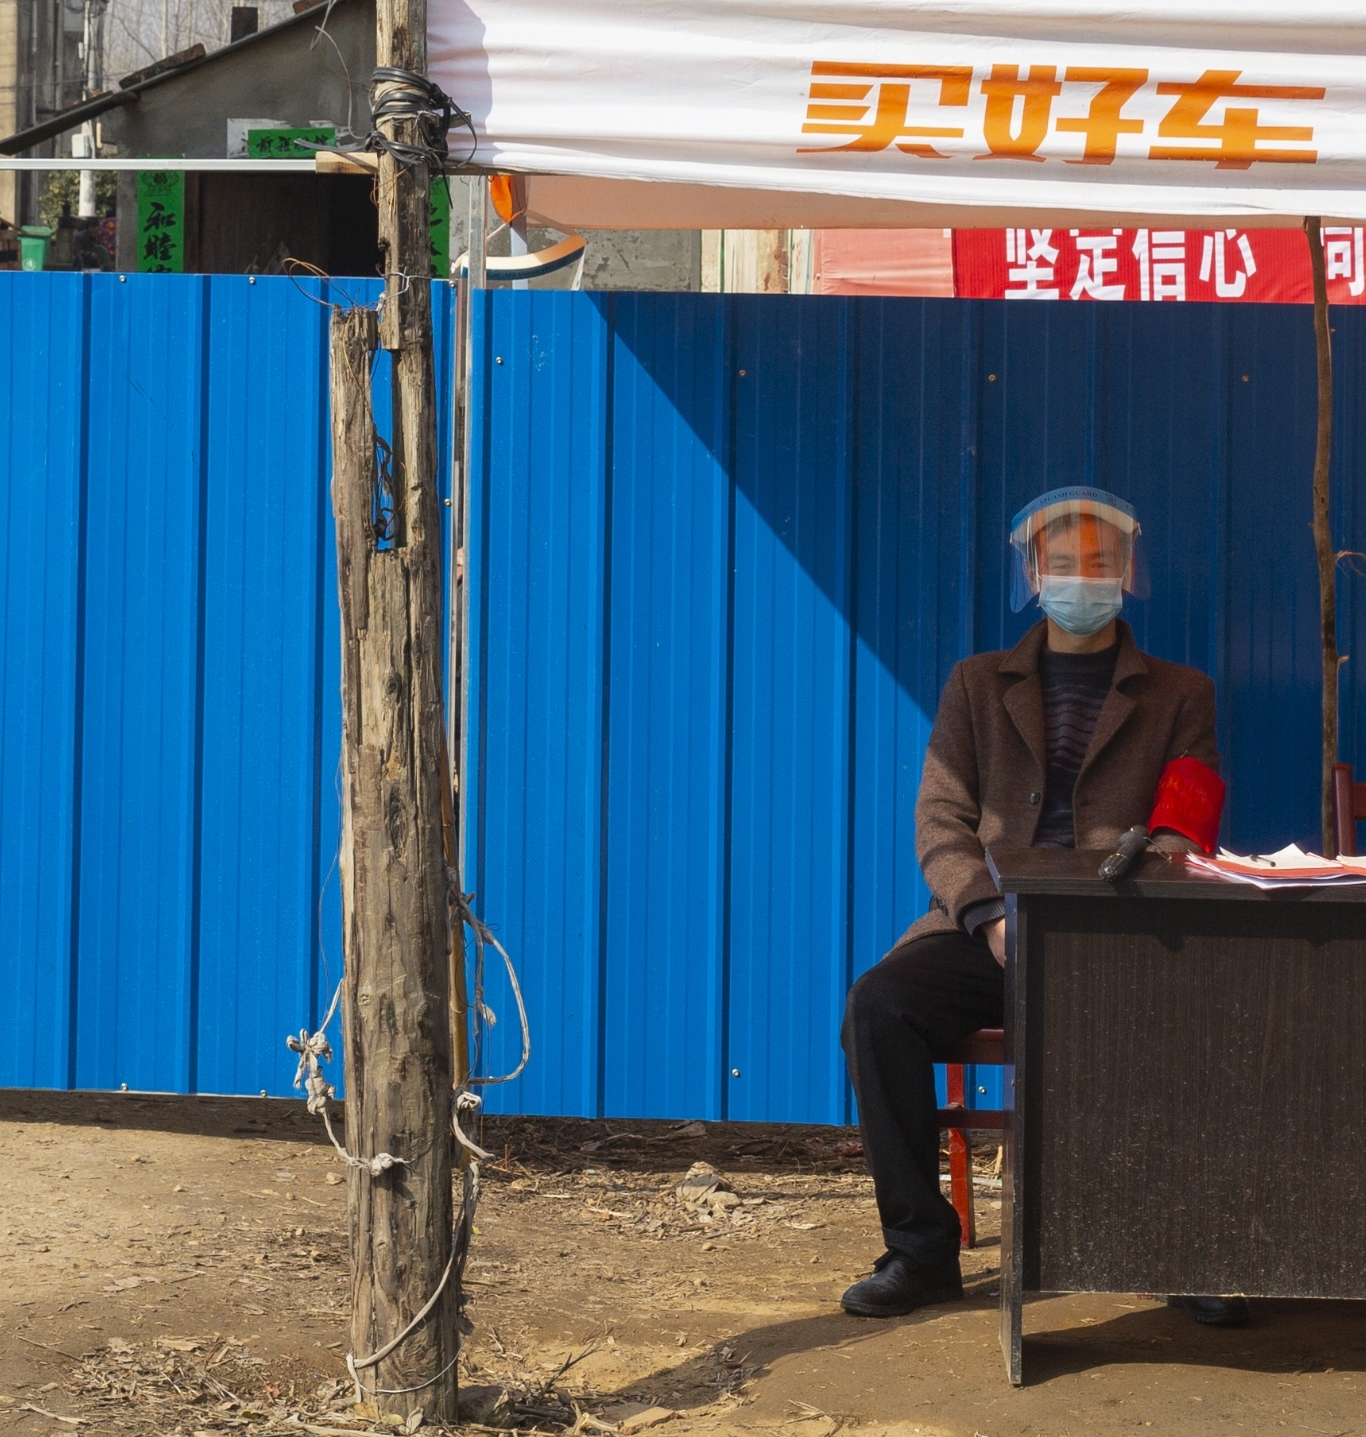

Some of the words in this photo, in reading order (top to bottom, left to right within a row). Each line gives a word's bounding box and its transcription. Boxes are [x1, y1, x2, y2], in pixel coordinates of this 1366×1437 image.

[796, 60, 1326, 170] 买好车
[143, 202, 177, 274] 和睦
